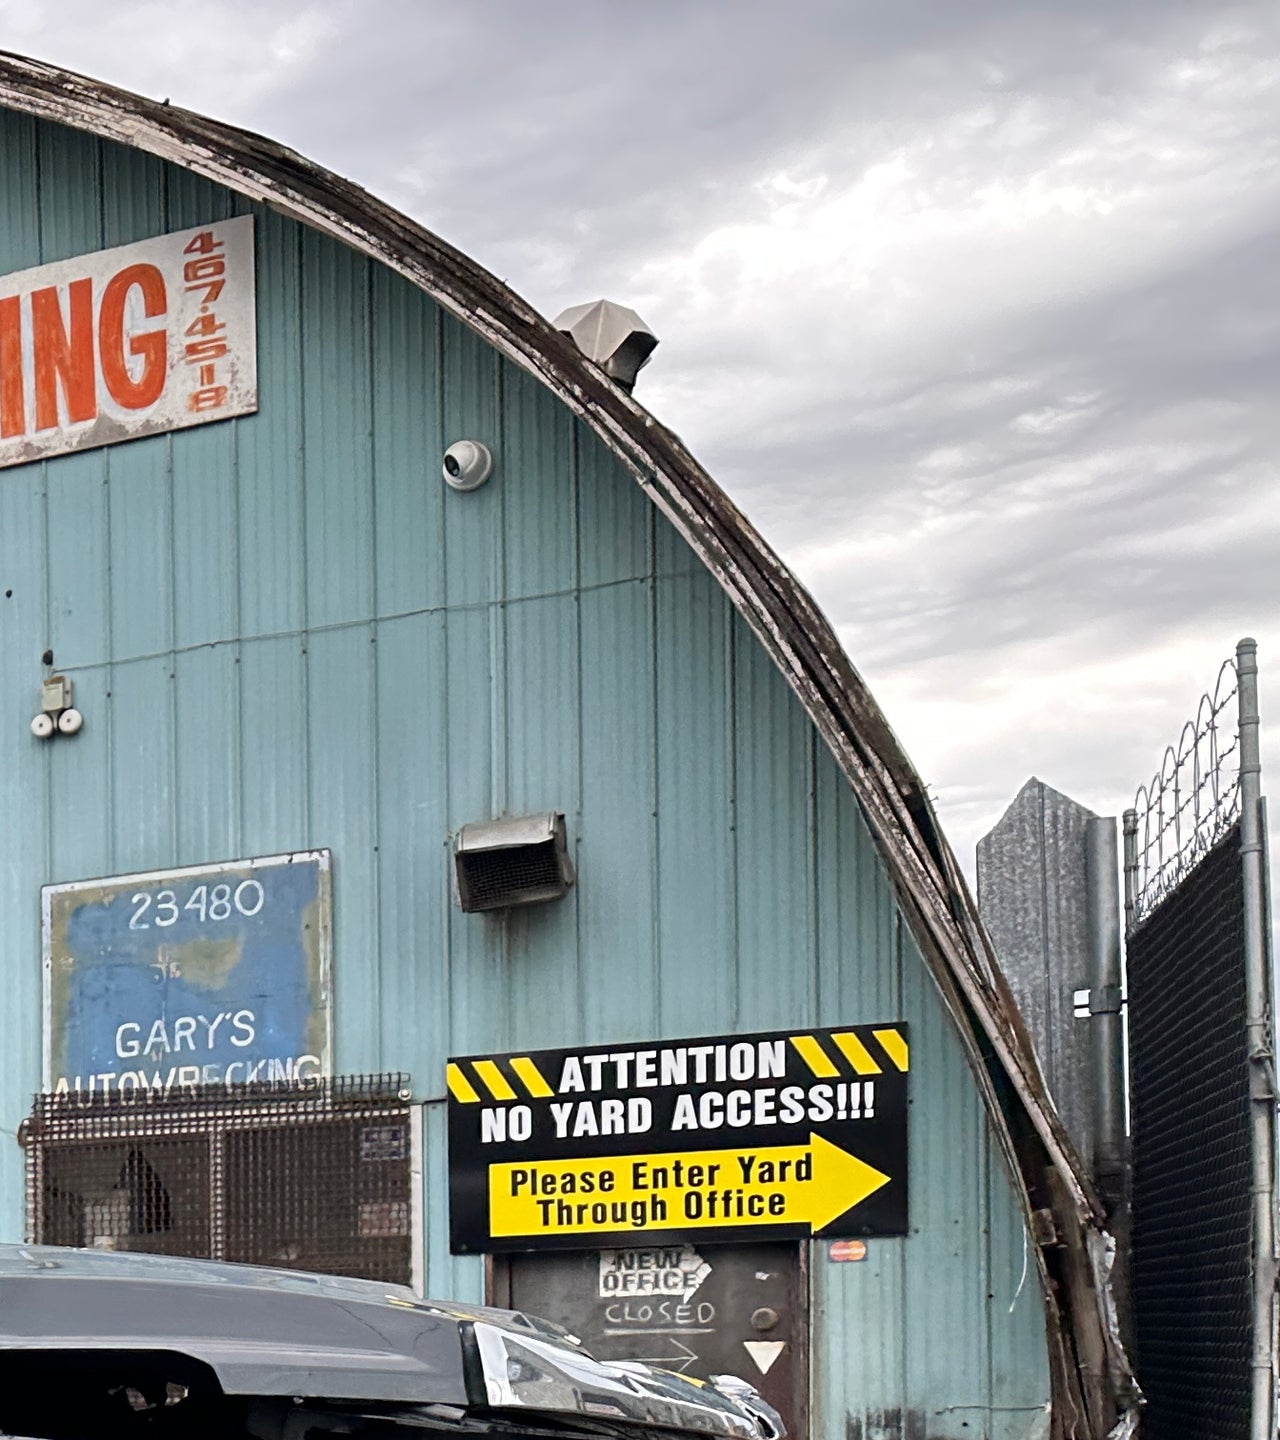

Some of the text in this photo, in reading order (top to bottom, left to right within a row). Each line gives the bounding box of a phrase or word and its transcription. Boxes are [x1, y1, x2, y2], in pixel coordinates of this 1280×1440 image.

[129, 879, 265, 931] 23480
[115, 1009, 256, 1059] GARY'S
[558, 1040, 786, 1094] ATTENTION
[481, 1081, 875, 1143] NO YARD ACCESS!!!
[511, 1152, 812, 1197] Please Enter Yard
[536, 1190, 786, 1228] Through Office
[602, 1271, 698, 1292] OFFICE
[617, 1250, 680, 1271] NEW
[605, 1301, 715, 1324] CLOSED
